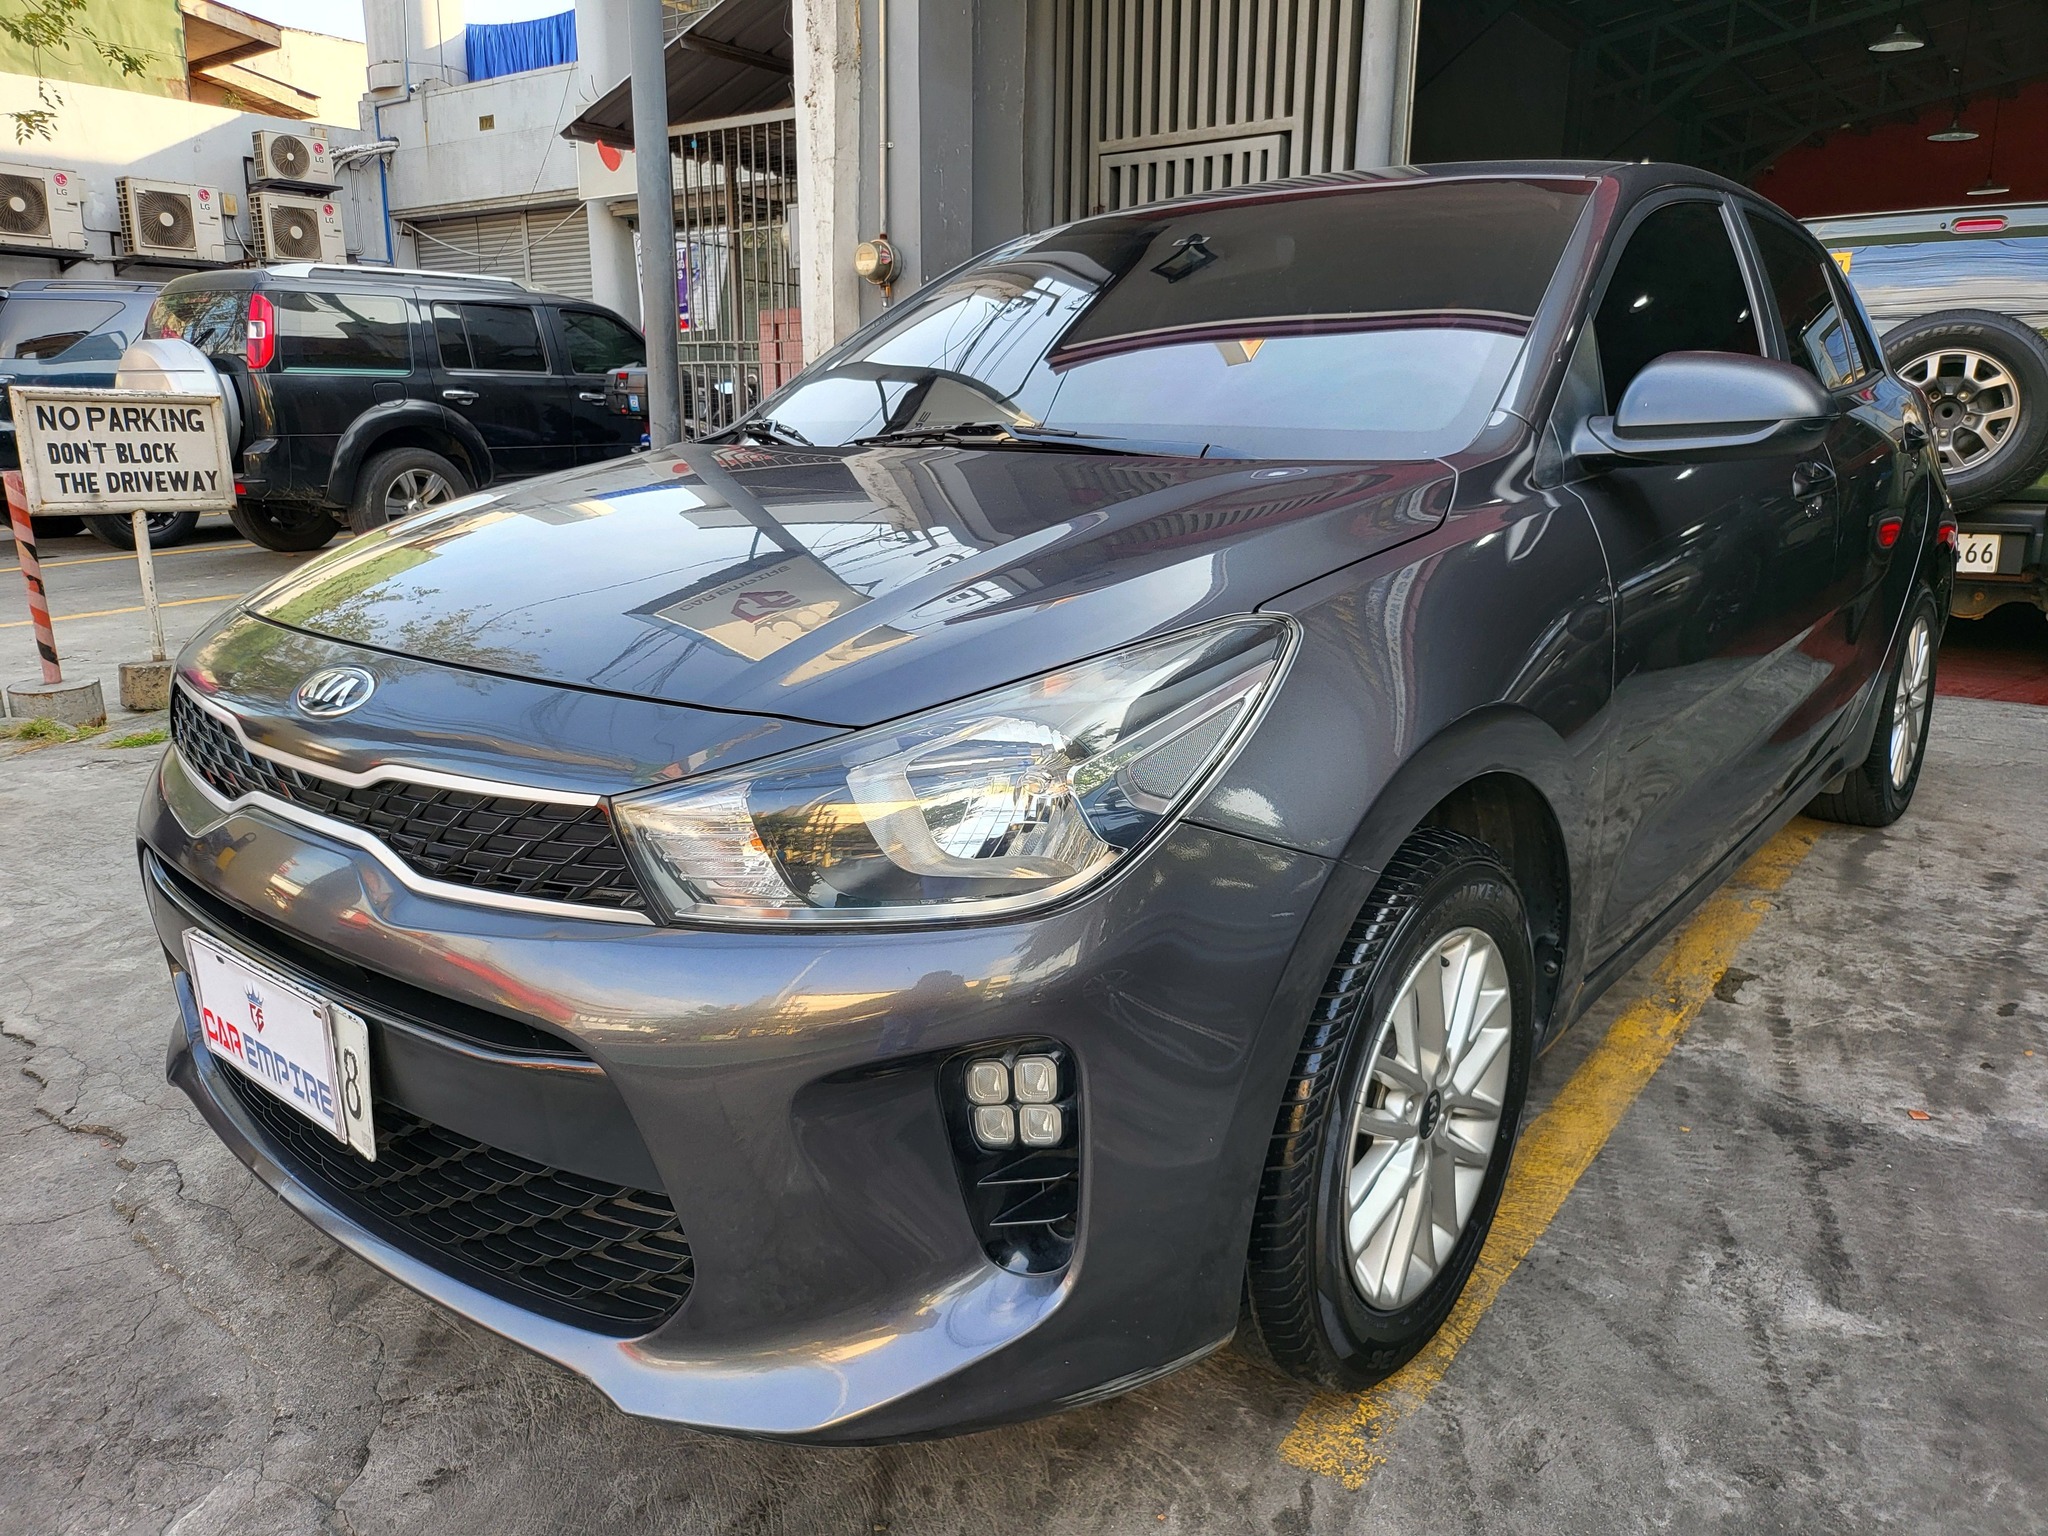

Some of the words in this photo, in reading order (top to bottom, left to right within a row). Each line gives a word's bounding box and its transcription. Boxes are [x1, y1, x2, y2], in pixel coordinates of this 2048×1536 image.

[314, 156, 325, 164] LG
[56, 187, 68, 196] LG
[200, 203, 211, 211] LG
[324, 216, 335, 224] LG
[36, 405, 81, 432] NO
[85, 406, 206, 433] PARKING
[47, 440, 107, 465] DON'T
[115, 442, 179, 464] BLOCK
[54, 471, 100, 494] THE
[105, 470, 218, 494] DRIVEWAY
[1958, 543, 1993, 564] 66
[300, 673, 360, 707] KIA
[203, 1007, 244, 1060] CAR
[243, 1032, 335, 1121] EMPIRE
[343, 1047, 363, 1121] 8
